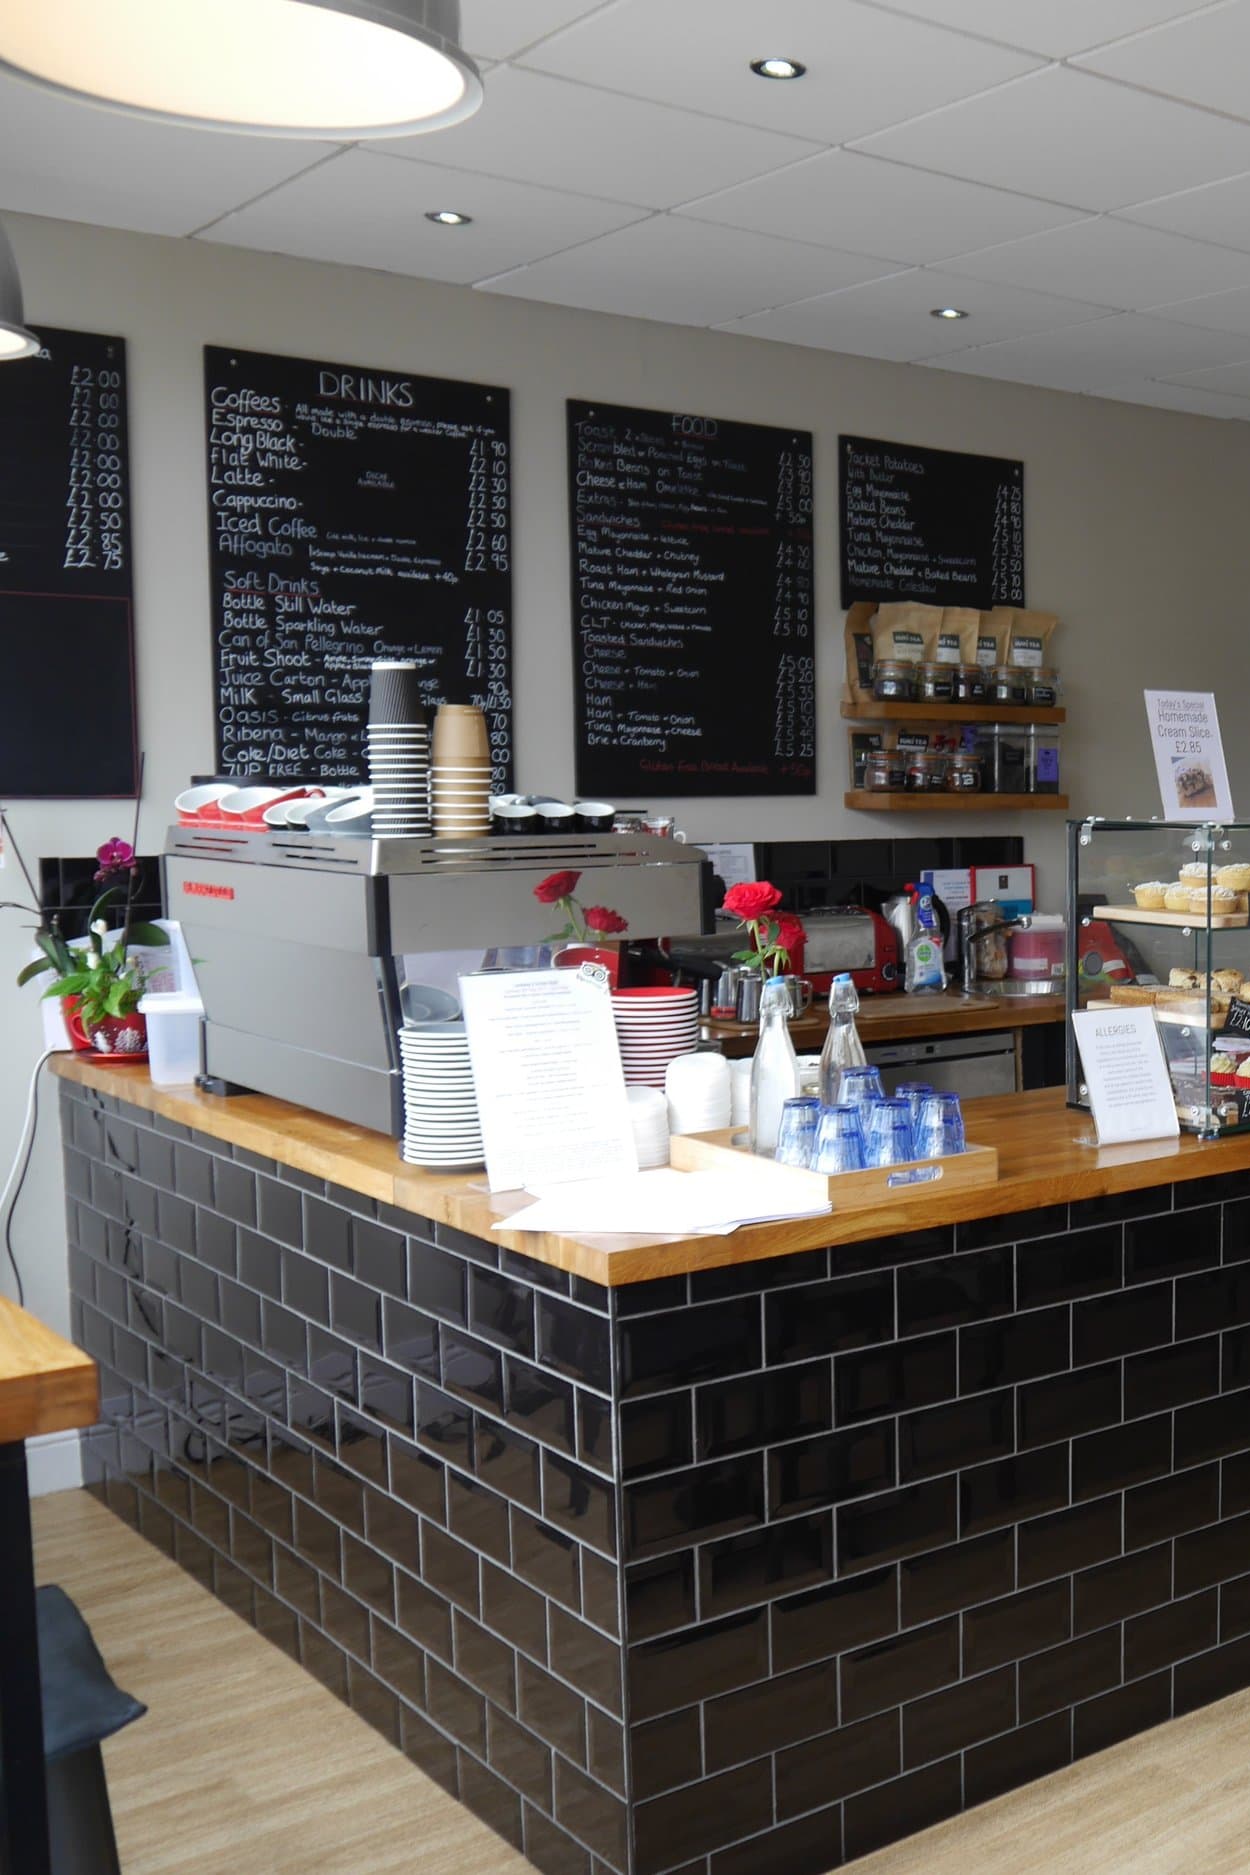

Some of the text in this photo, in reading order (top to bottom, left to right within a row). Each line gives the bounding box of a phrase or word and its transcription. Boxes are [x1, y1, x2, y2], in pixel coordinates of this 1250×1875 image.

[210, 386, 281, 413] Coffees
[319, 371, 414, 407] DRINKS
[211, 408, 283, 432] Espresso
[672, 416, 718, 437] FOOD
[210, 427, 297, 454] Long Black
[311, 422, 357, 440] Double
[256, 451, 302, 470] White
[211, 465, 265, 486] Latte
[212, 489, 298, 514] Cappuccino
[216, 511, 262, 535] Iced
[267, 516, 318, 539] Coffee
[219, 533, 294, 559] Affogato
[224, 570, 320, 595] Soft Drinks
[222, 592, 358, 615] Bottle Still Water
[223, 611, 385, 637] Bottle Sparkling Water
[218, 629, 251, 648] Can
[255, 630, 271, 647] of
[274, 633, 298, 650] San
[305, 633, 365, 655] Pellegrino
[220, 648, 260, 668] Fruit
[262, 648, 312, 668] Shoot
[220, 666, 325, 687] Juice Carton
[280, 689, 320, 704] Small
[324, 689, 364, 704] Glass
[220, 706, 280, 724] Oasis
[1158, 710, 1209, 722] Homemade
[222, 725, 286, 743] Ribena
[1157, 725, 1210, 738] Cream Slice
[313, 745, 348, 760] Coke
[1175, 741, 1202, 753] £2.85
[320, 764, 360, 777] Bottle
[1095, 1024, 1137, 1037] ALLERGIES
